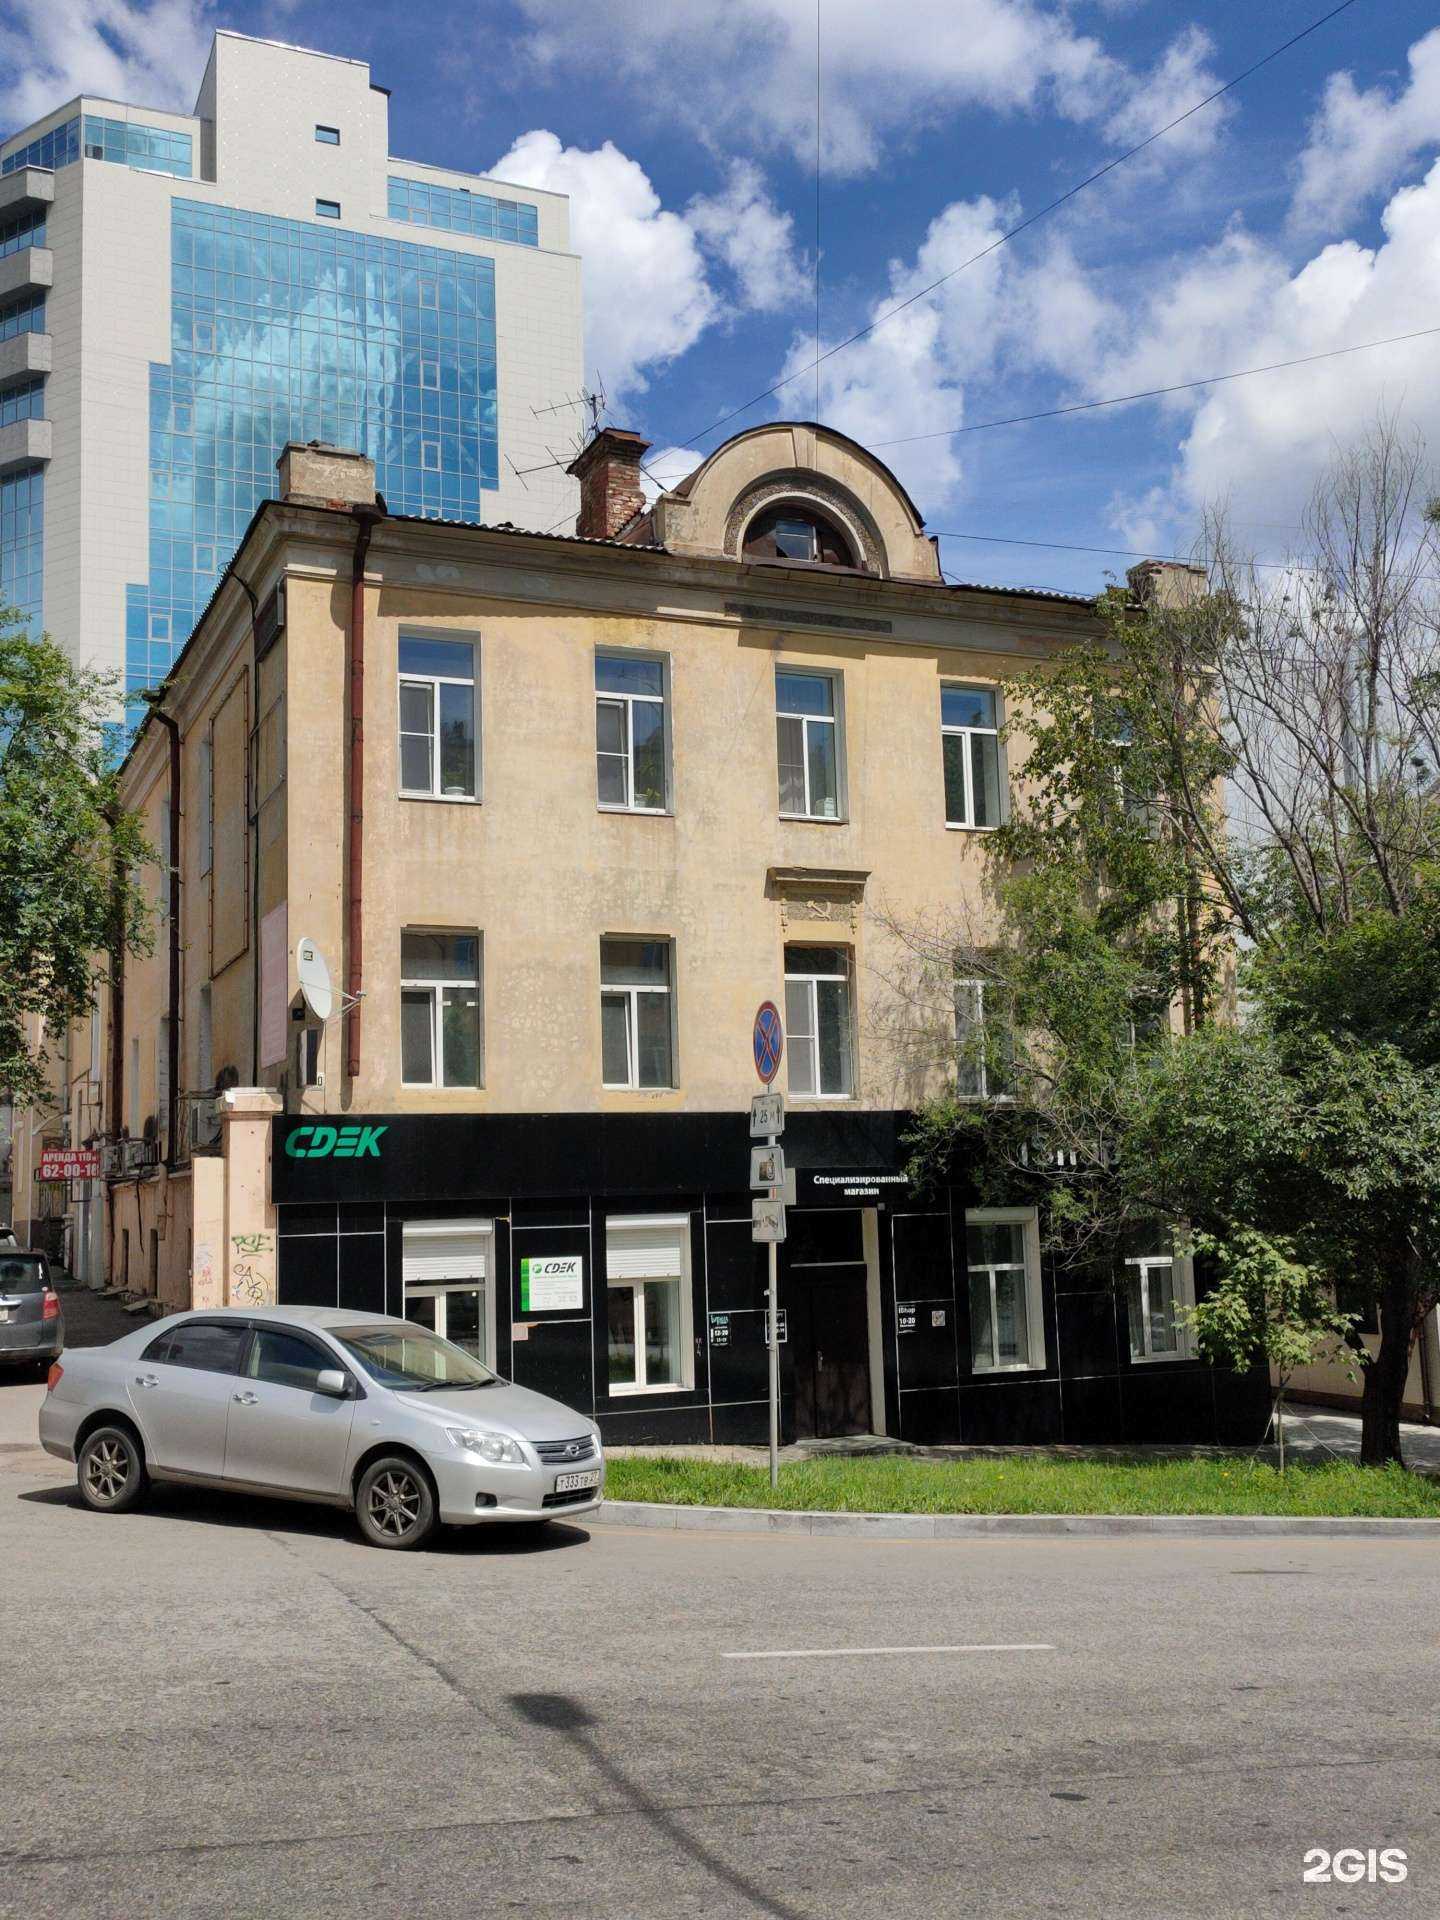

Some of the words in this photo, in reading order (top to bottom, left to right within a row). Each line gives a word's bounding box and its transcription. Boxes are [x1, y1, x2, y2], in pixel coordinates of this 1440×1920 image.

[285, 1126, 389, 1158] CDEK
[43, 1152, 77, 1162] АРЕНДА
[813, 1174, 909, 1186] Специализированный
[843, 1187, 880, 1196] магазин
[544, 1262, 576, 1274] CDEK
